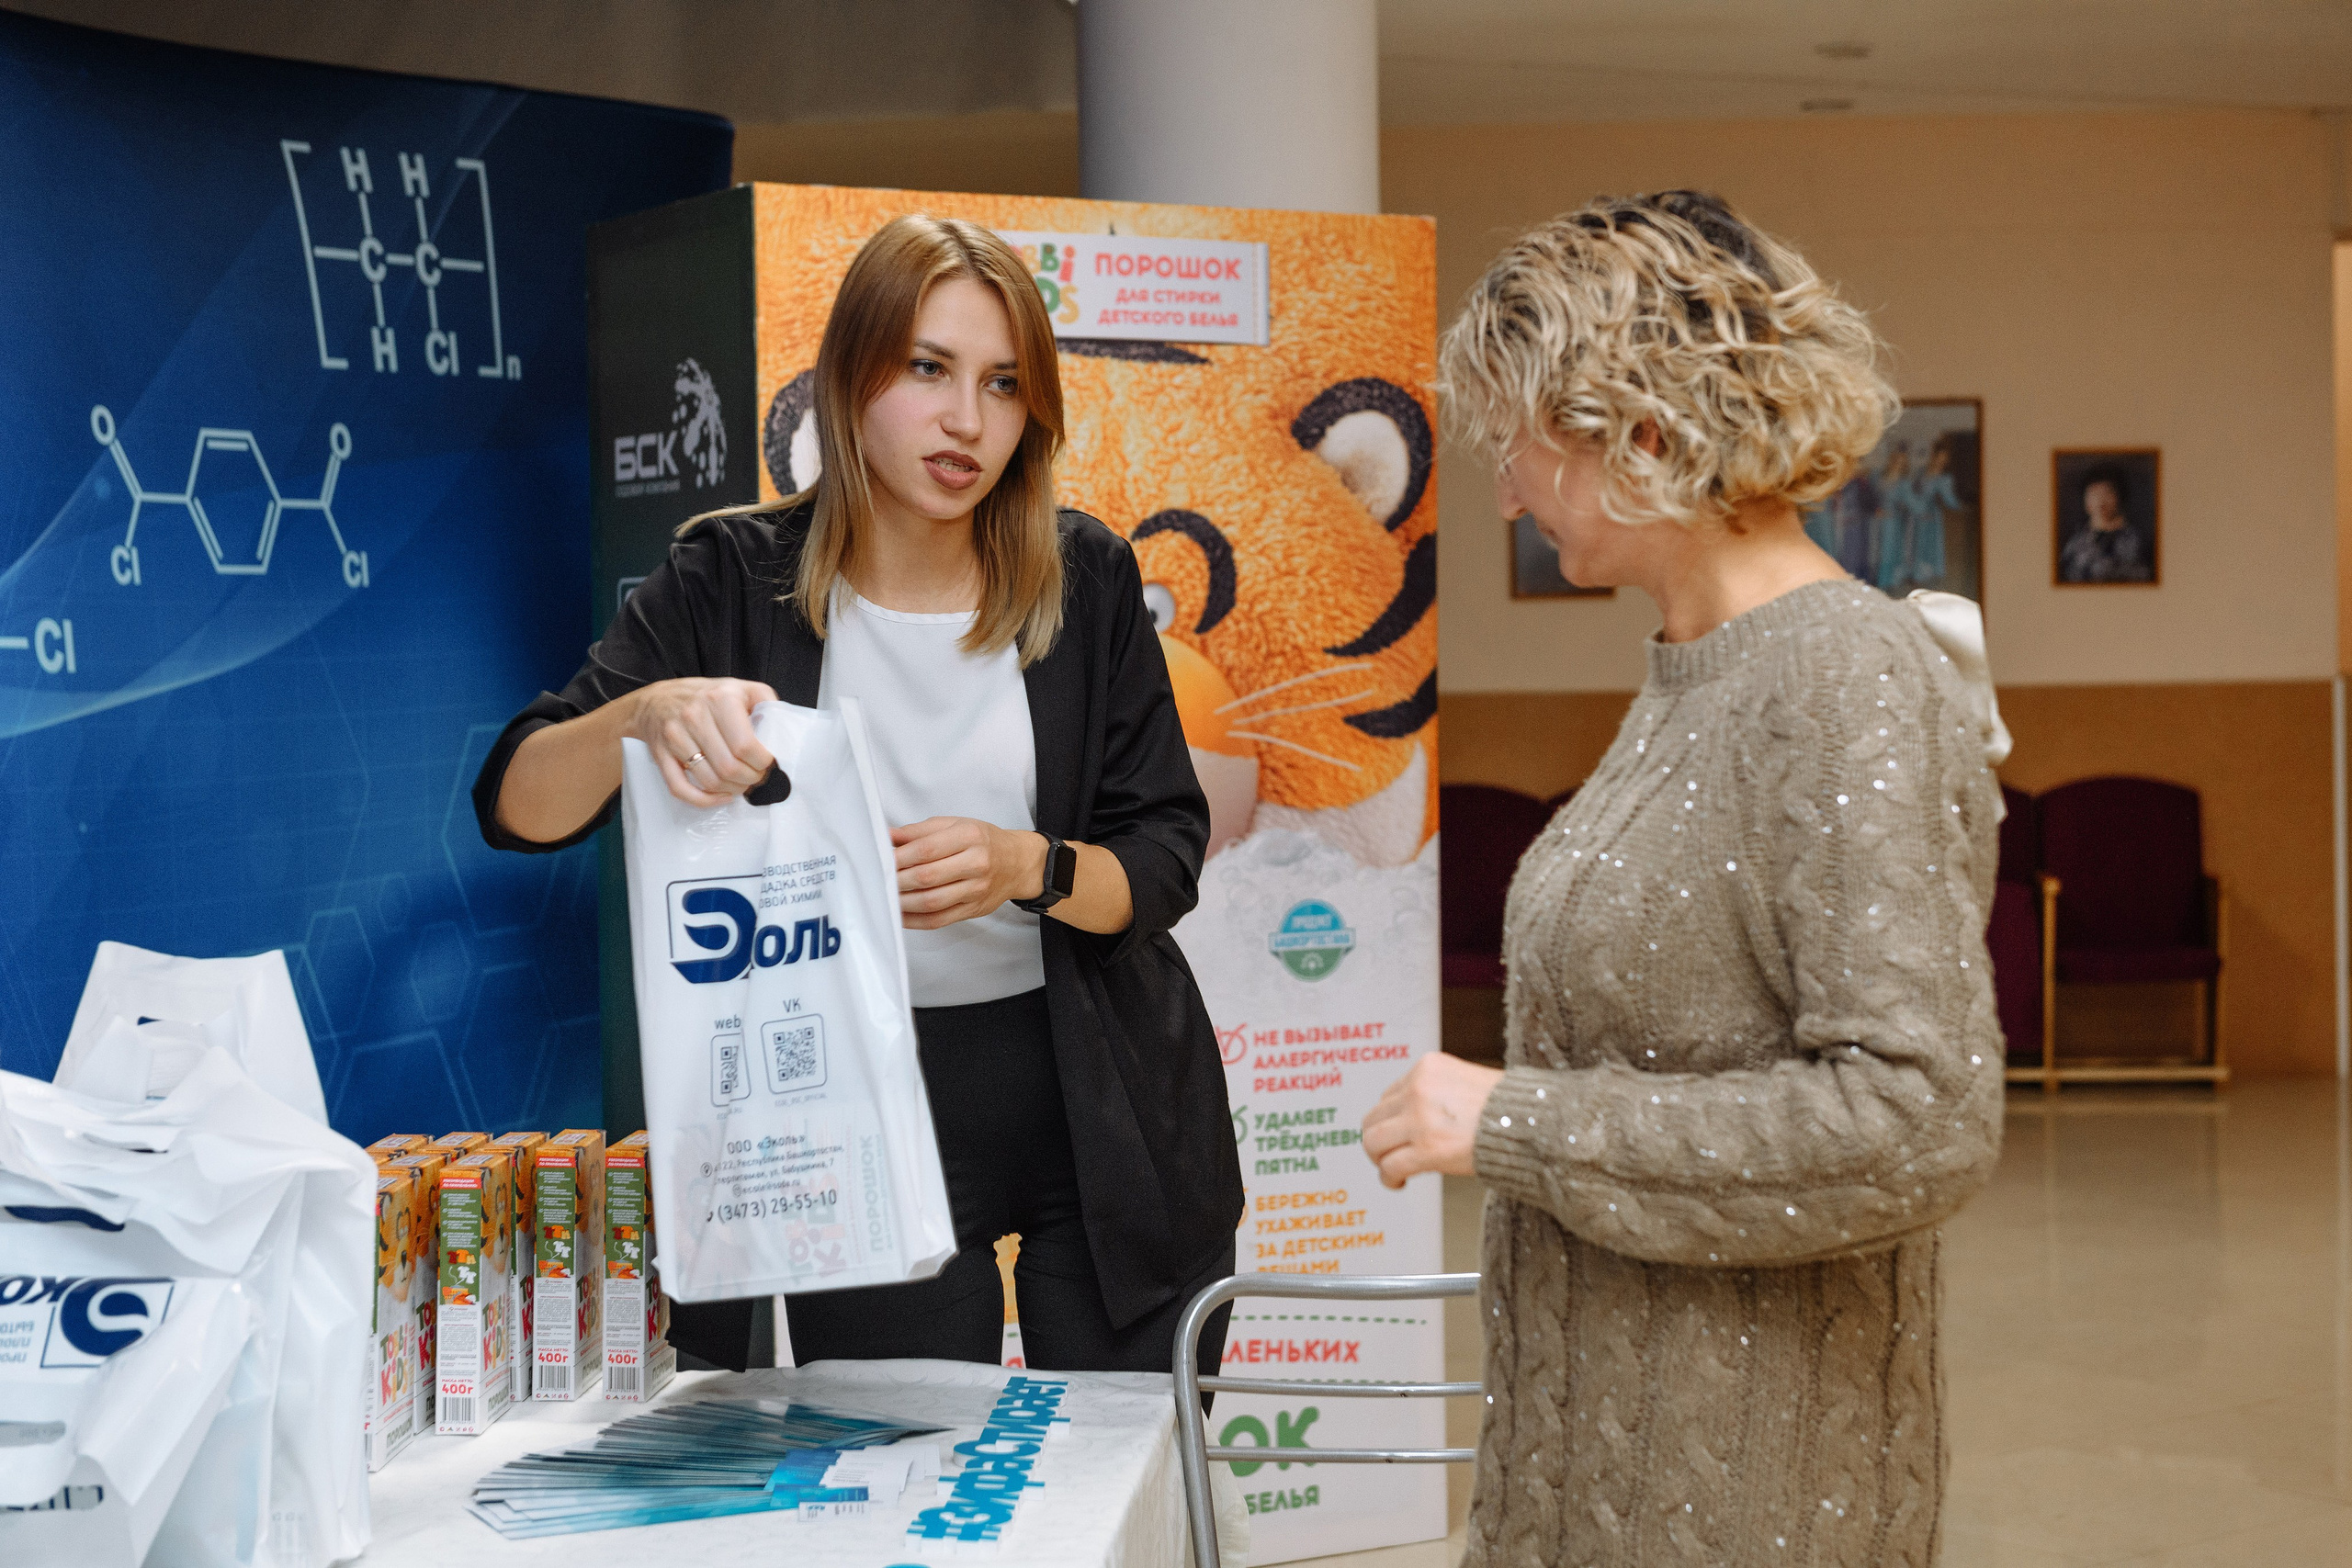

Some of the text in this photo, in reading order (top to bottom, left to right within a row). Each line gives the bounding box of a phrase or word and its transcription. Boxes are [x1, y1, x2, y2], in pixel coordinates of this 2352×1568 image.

[1095, 252, 1241, 280] ПОРОШОК
[1115, 288, 1221, 304] ДЛЯ СТИРКИ
[1098, 309, 1238, 326] ДЕТСКОГО БЕЛЬЯ
[615, 430, 679, 481] БСК
[782, 998, 801, 1013] VK
[715, 1014, 741, 1030] web
[1253, 1022, 1385, 1046] НЕ ВЫЗЫВАЕТ
[1253, 1044, 1409, 1070] АЛЛЕРГИЧЕСКИХ
[1253, 1066, 1342, 1093] РЕАКЦИЙ
[1254, 1107, 1337, 1132] УДАЛЯЕТ
[727, 1139, 752, 1155] ООО
[1255, 1156, 1319, 1176] ПЯТНА
[718, 1189, 837, 1224] (3473) 29-55-10
[1255, 1189, 1348, 1213] БЕРЕЖНО
[1255, 1210, 1366, 1235] УХАЖИВАЕТ
[1256, 1231, 1385, 1258] ЗА ДЕТСКИМИ
[537, 1353, 569, 1363] 400г
[607, 1353, 639, 1364] 400г
[1222, 1338, 1361, 1363] ЛЕНЬКИХ
[442, 1383, 474, 1394] 400г
